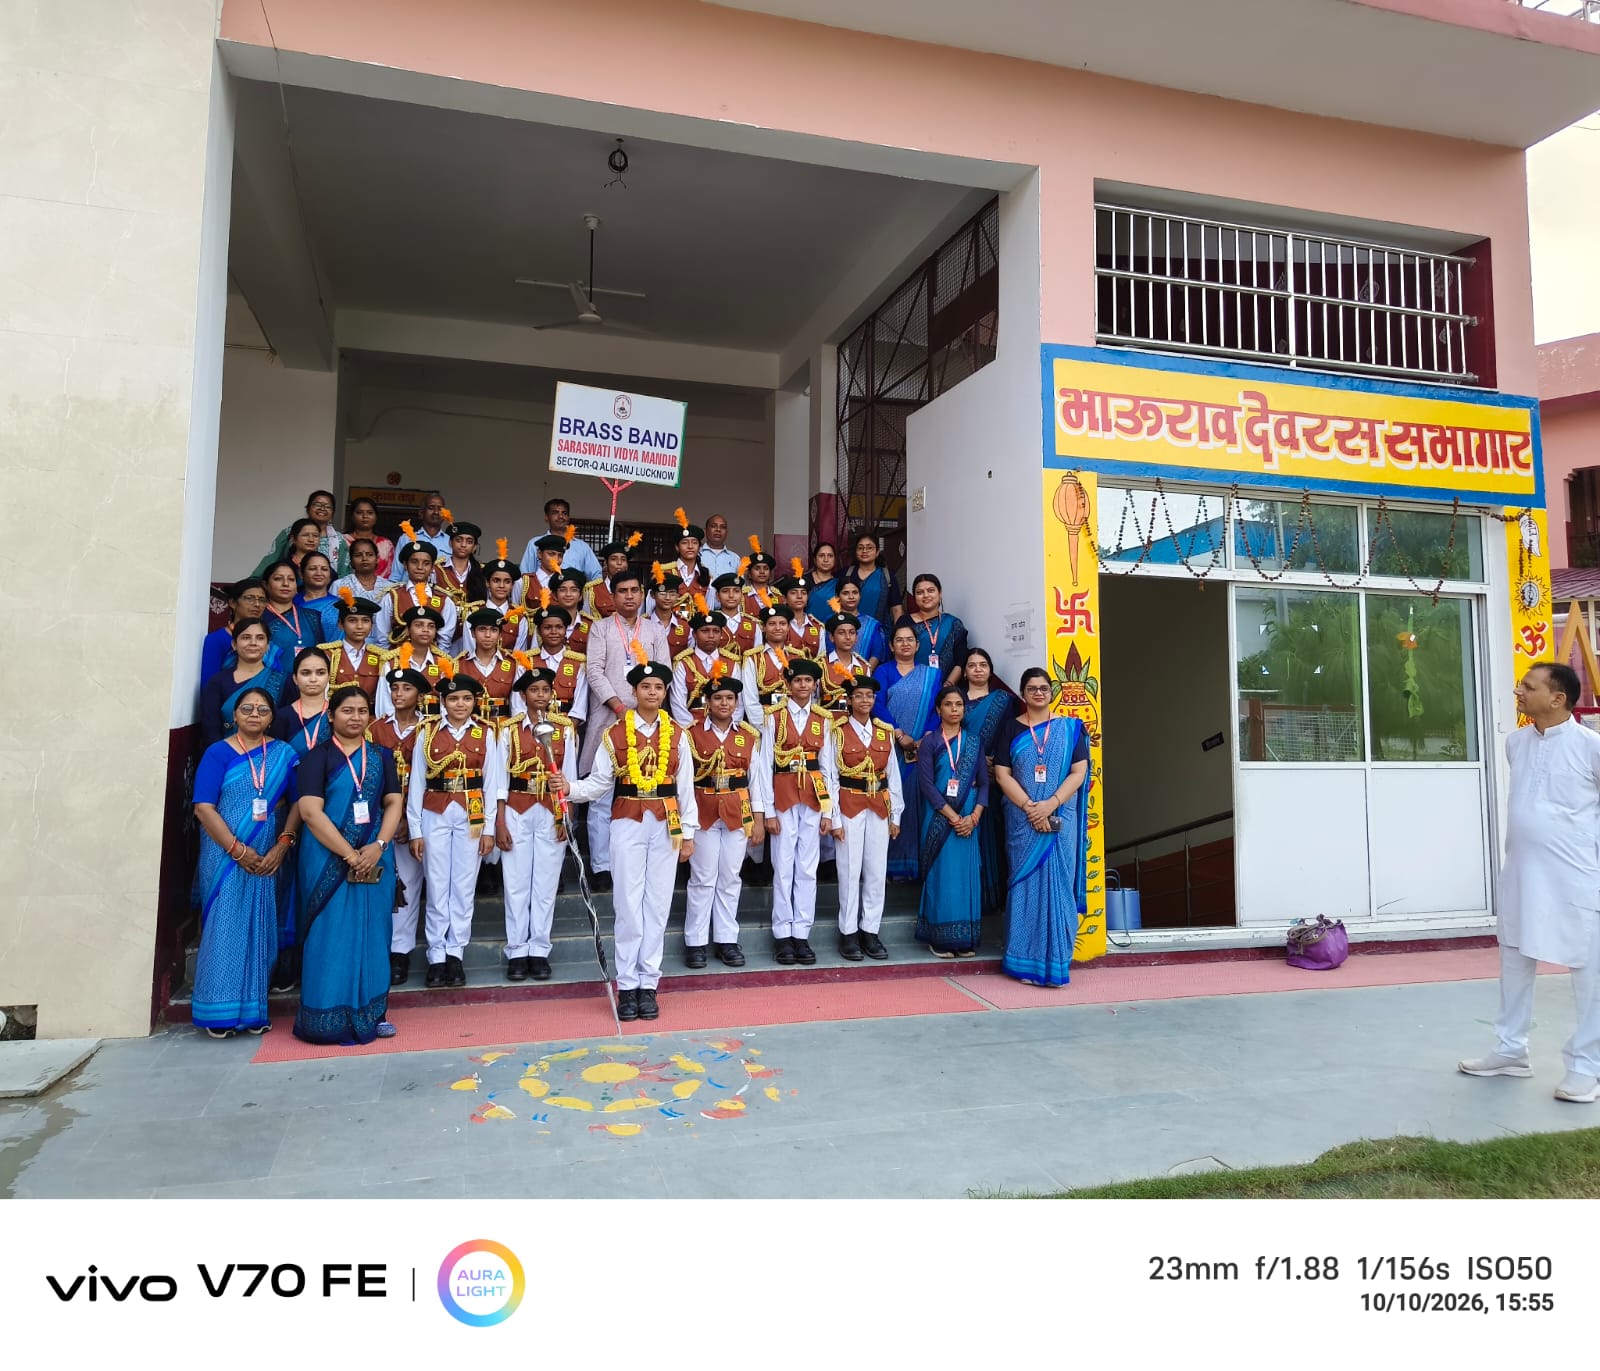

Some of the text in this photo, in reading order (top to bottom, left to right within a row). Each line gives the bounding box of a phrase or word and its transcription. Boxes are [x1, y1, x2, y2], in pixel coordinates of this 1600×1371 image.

[559, 416, 678, 450] BRASS BAND
[1059, 387, 1532, 471] भाऊराव देवरस सभागार
[556, 456, 676, 481] SECTOR-Q ALIGANJ LUCKNOW
[557, 438, 678, 468] SARASWATI VIDYA MANDIR
